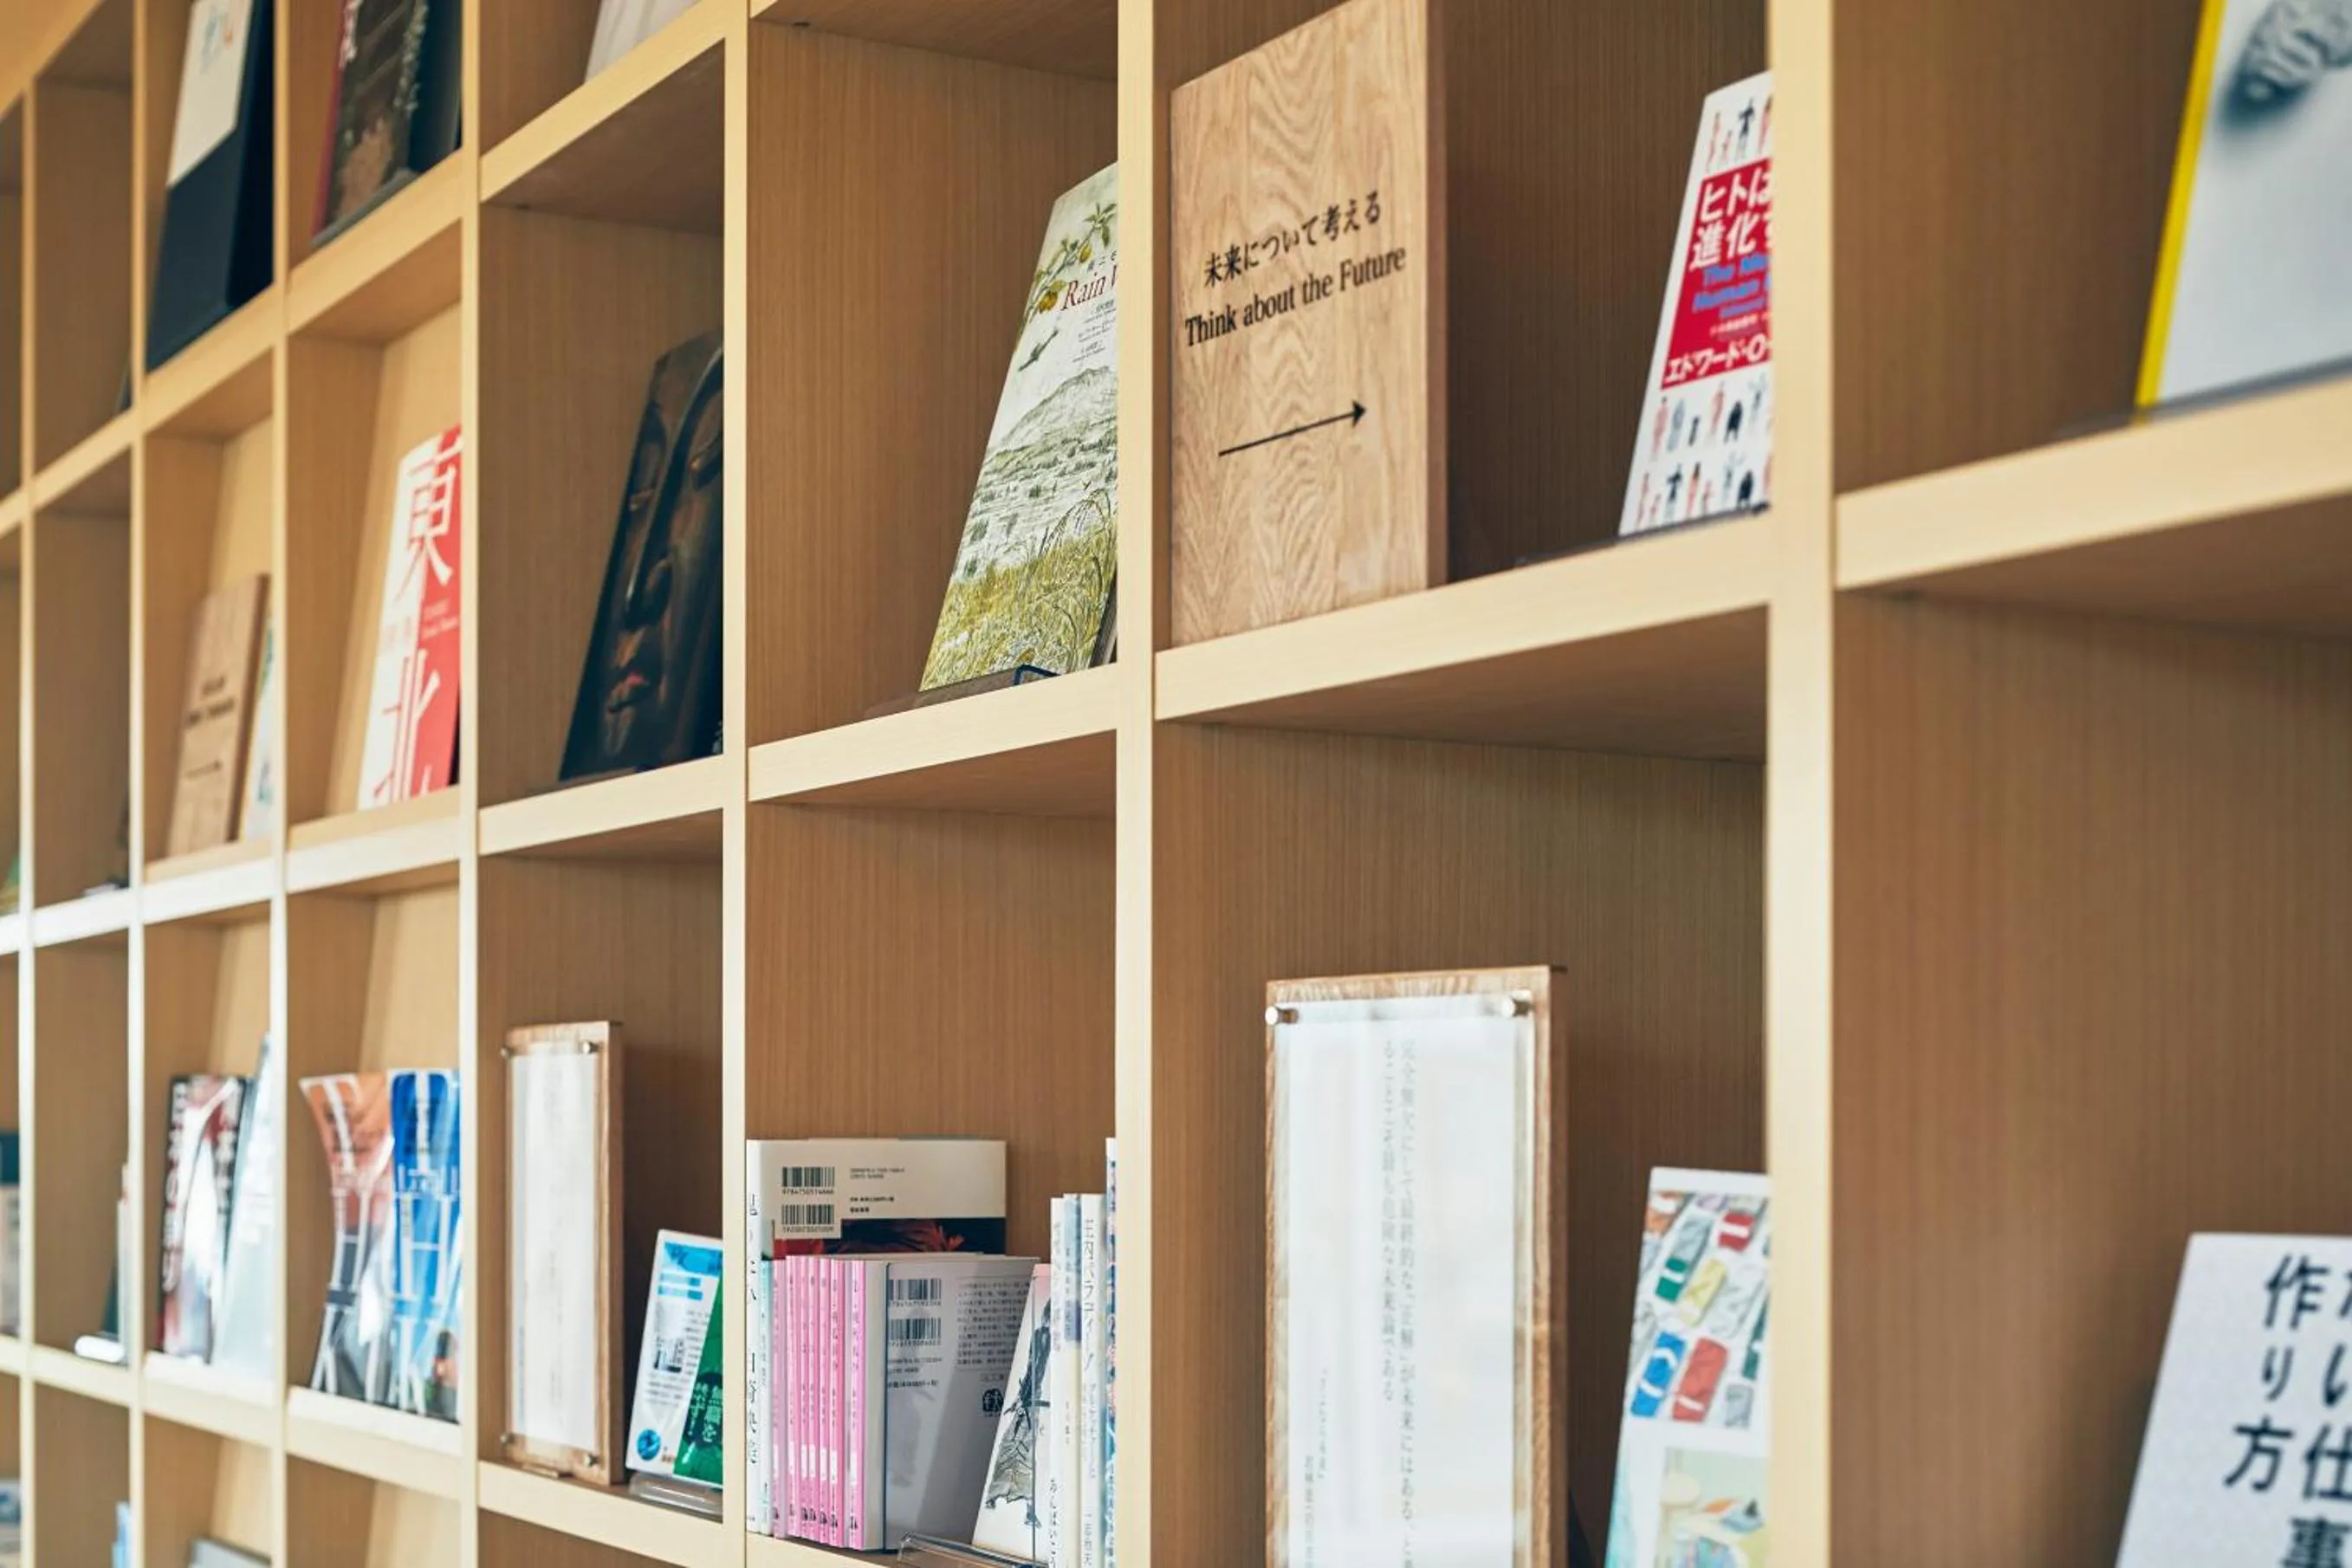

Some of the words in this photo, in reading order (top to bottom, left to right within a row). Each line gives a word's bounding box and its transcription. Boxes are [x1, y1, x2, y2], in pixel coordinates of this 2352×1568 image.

[1061, 270, 1106, 311] Rain
[1202, 189, 1382, 289] 未来について考える
[1185, 304, 1239, 347] Think
[1242, 286, 1296, 327] about
[1301, 273, 1333, 306] the
[1339, 244, 1407, 292] Future
[2224, 1254, 2331, 1493] 作り方
[2280, 1273, 2352, 1568] い仕事
